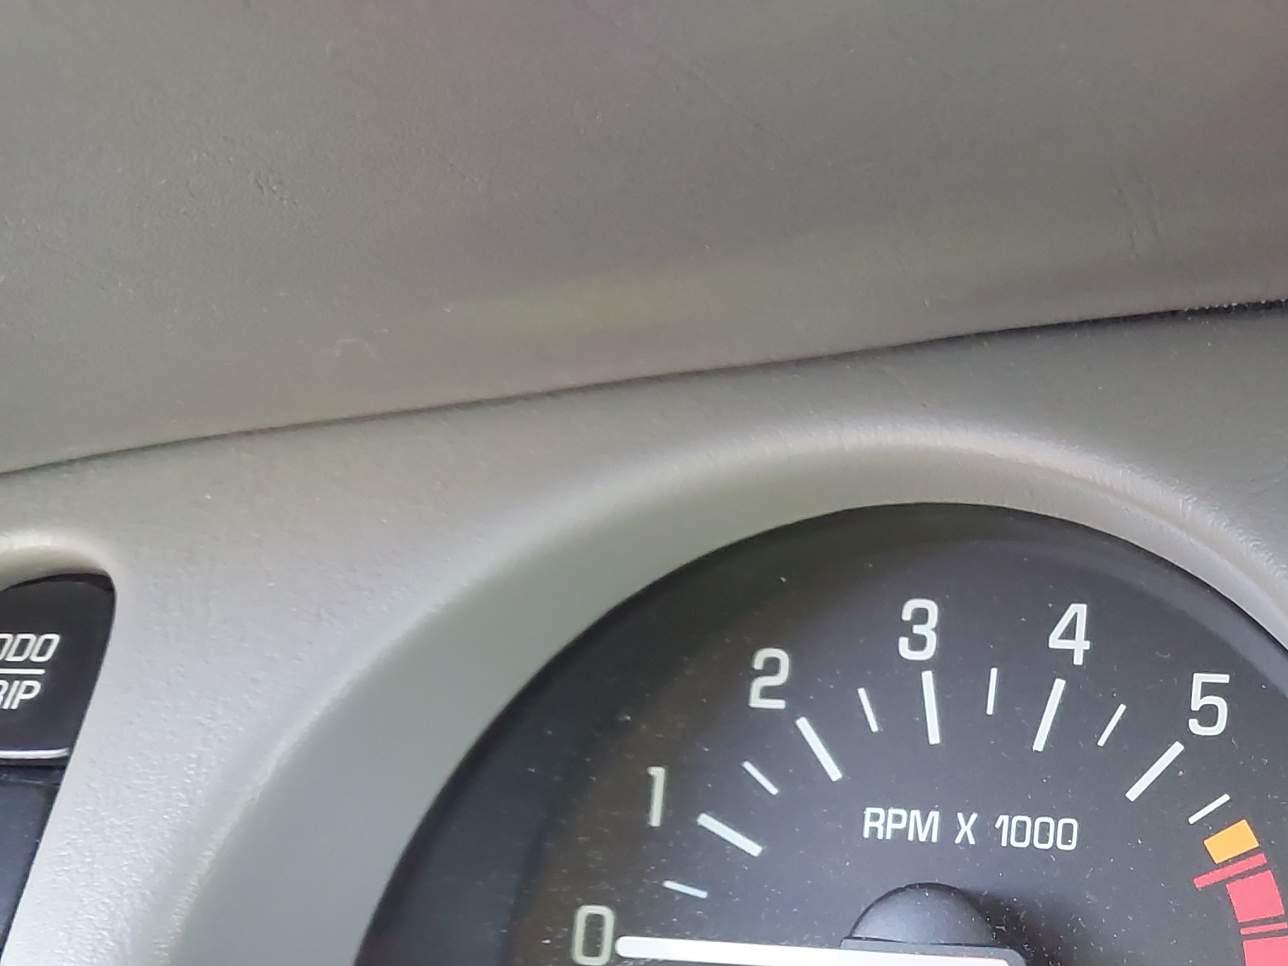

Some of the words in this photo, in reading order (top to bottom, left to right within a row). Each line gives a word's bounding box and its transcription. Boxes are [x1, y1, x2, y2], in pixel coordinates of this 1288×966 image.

[898, 598, 939, 661] 3
[1048, 603, 1091, 666] 4
[748, 648, 790, 710] 2
[1188, 672, 1230, 736] 5
[647, 766, 666, 827] 1
[863, 807, 940, 843] RPM
[954, 812, 978, 845] X
[994, 814, 1079, 851] 1000
[572, 905, 616, 966] 0
